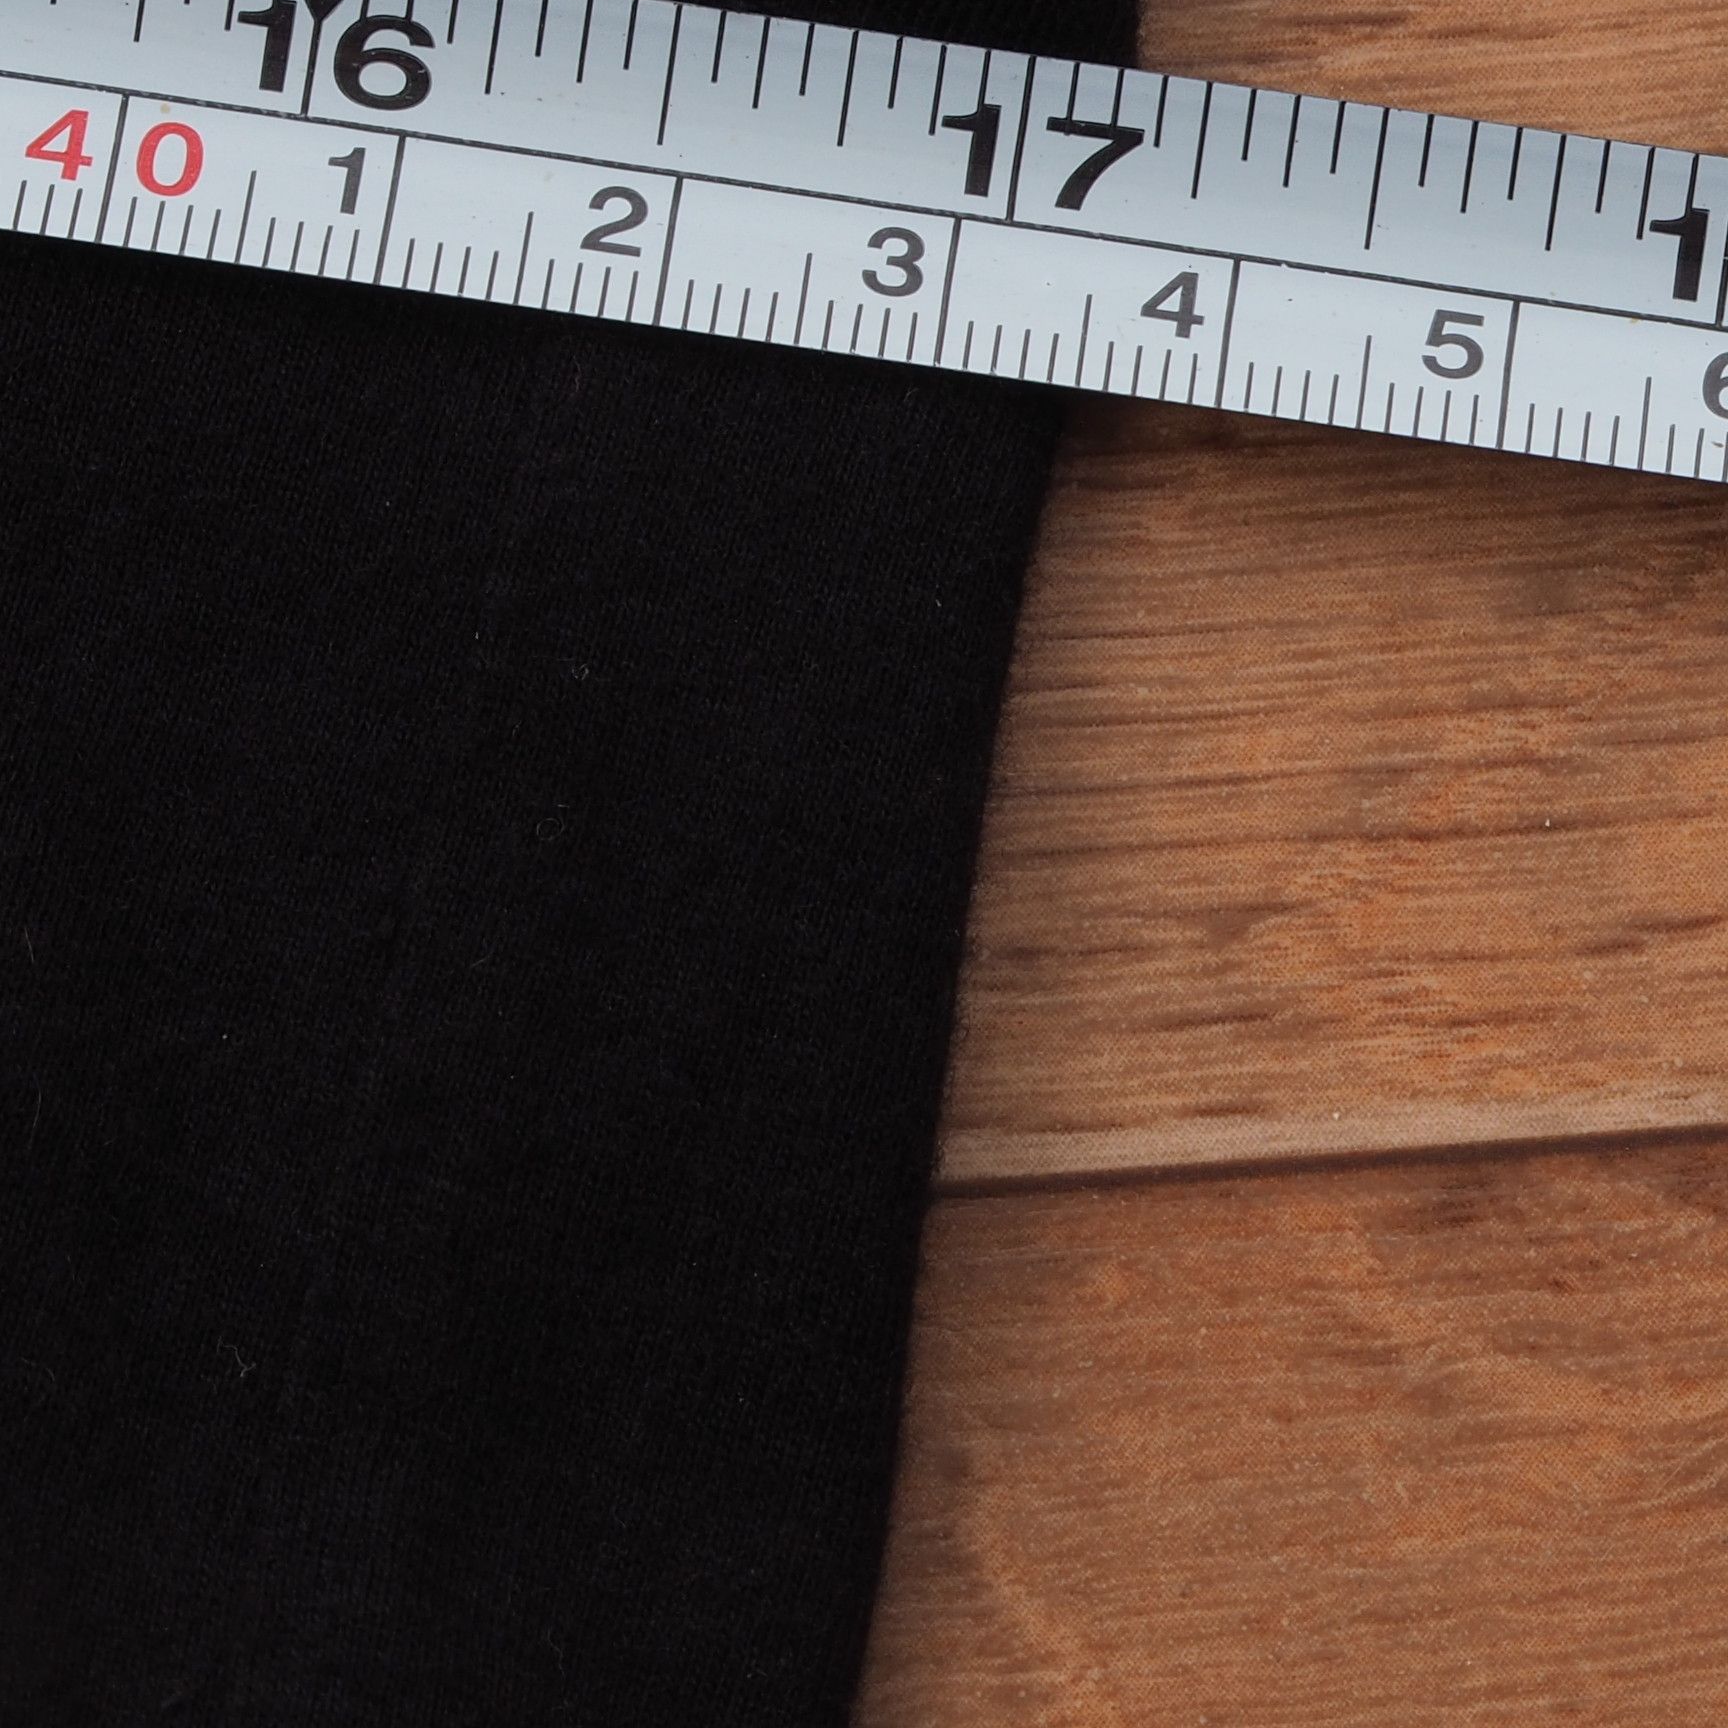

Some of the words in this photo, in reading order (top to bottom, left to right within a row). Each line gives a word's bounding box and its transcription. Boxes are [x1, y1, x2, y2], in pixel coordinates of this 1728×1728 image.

[24, 108, 205, 198] 40
[327, 146, 369, 215] 1
[579, 185, 650, 259] 2
[860, 226, 927, 298] 3
[1139, 271, 1206, 339] 4
[1420, 309, 1486, 381] 5
[940, 103, 1146, 211] 17
